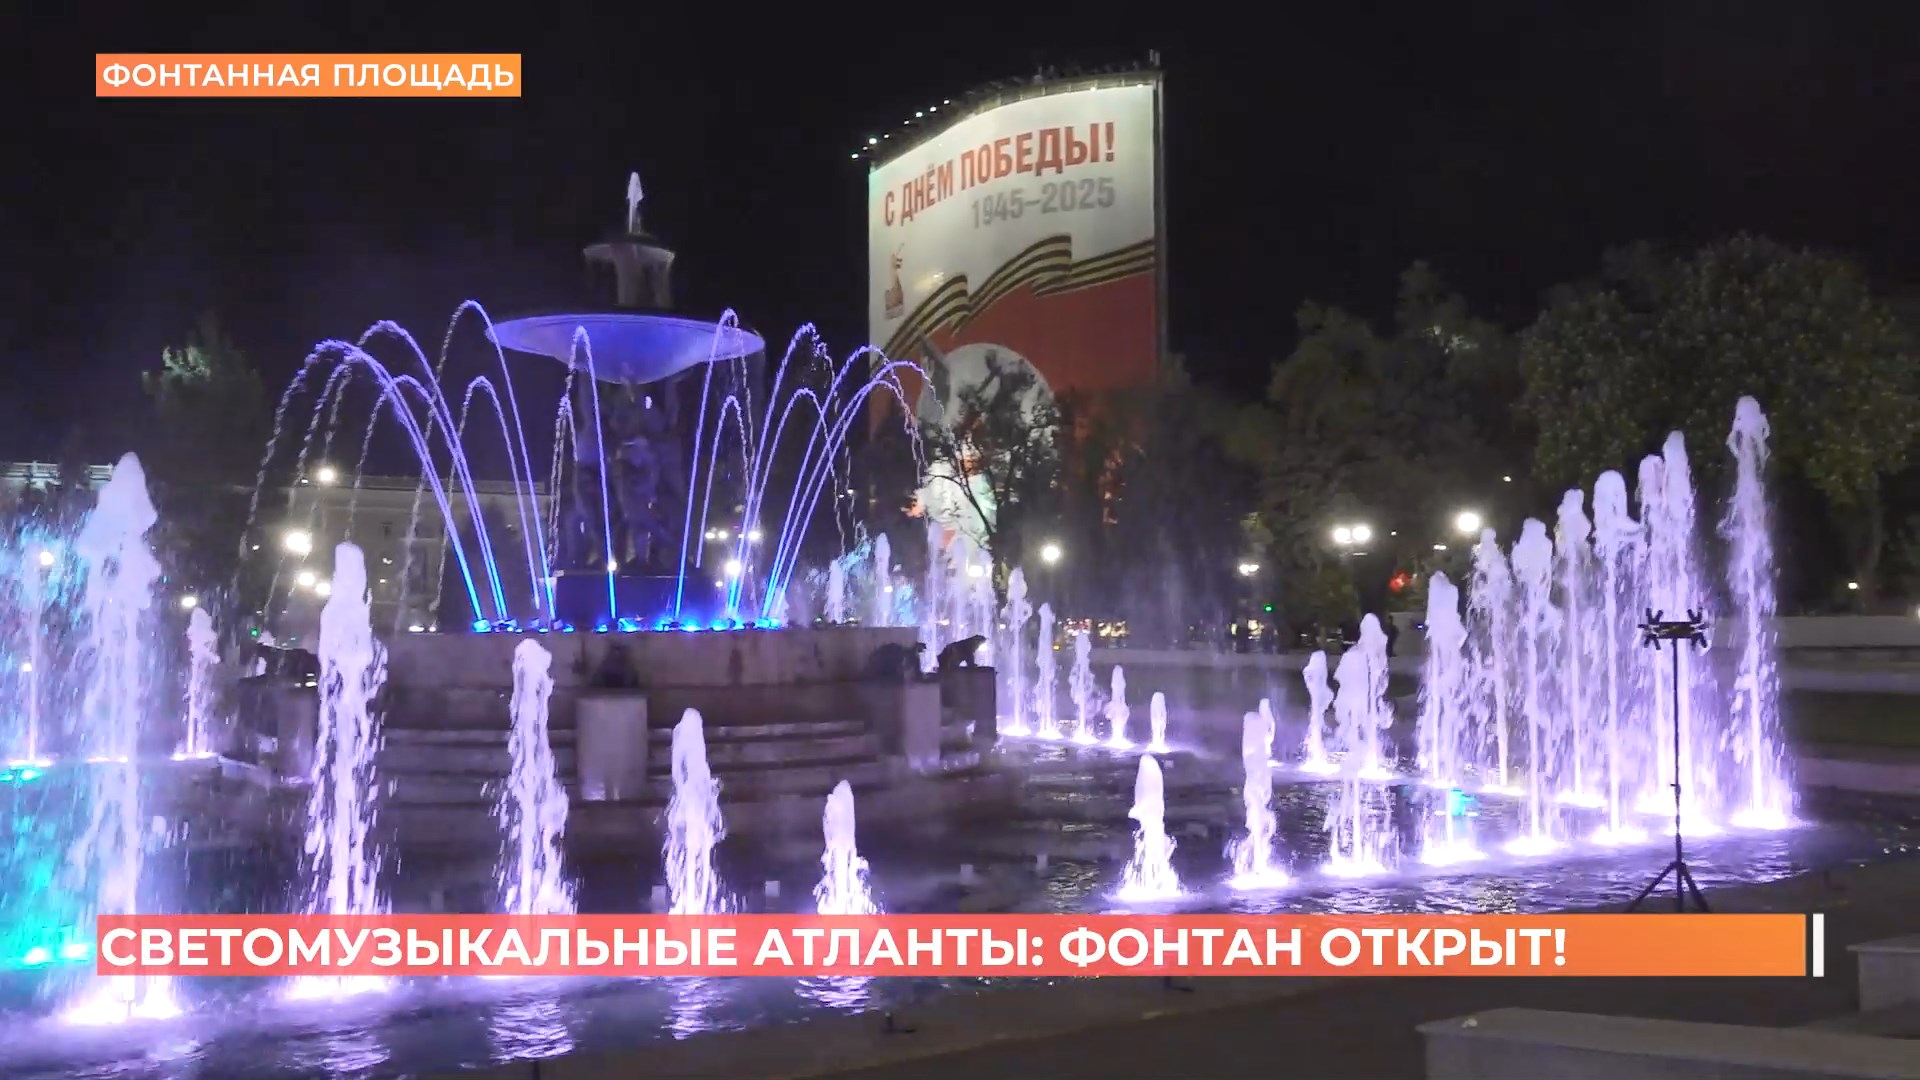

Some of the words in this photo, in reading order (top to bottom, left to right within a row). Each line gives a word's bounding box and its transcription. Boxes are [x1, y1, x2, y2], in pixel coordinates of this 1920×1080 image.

[884, 191, 896, 226] С
[900, 162, 954, 226] ДНЁМ
[960, 121, 1115, 191] ПОБЕДЫ!
